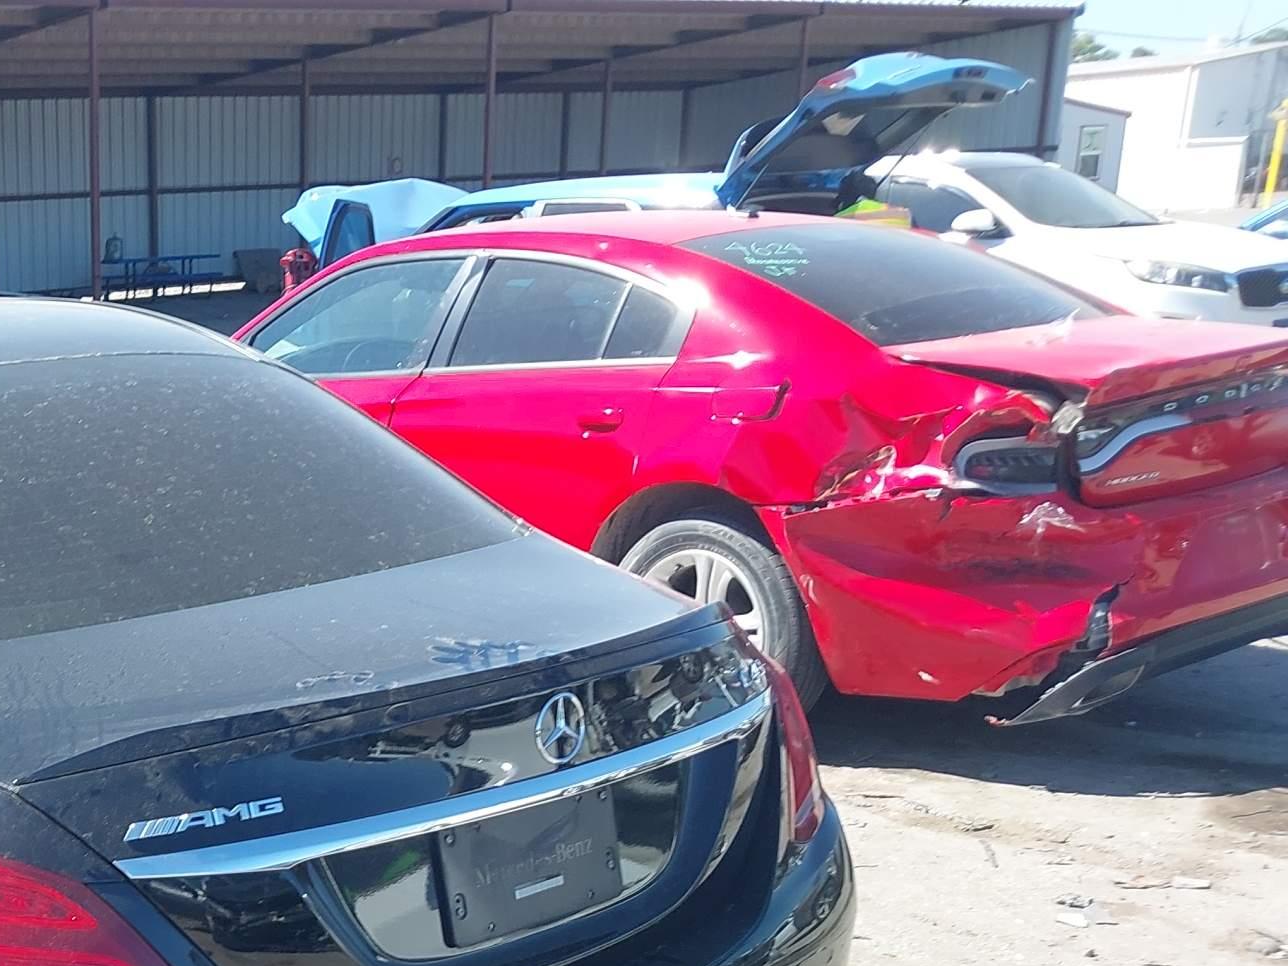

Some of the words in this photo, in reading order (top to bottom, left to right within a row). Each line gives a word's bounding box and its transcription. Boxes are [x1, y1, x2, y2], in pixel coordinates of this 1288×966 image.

[724, 240, 808, 257] 4624
[175, 796, 286, 832] AMG
[473, 837, 594, 888] Mercedes-Benz
